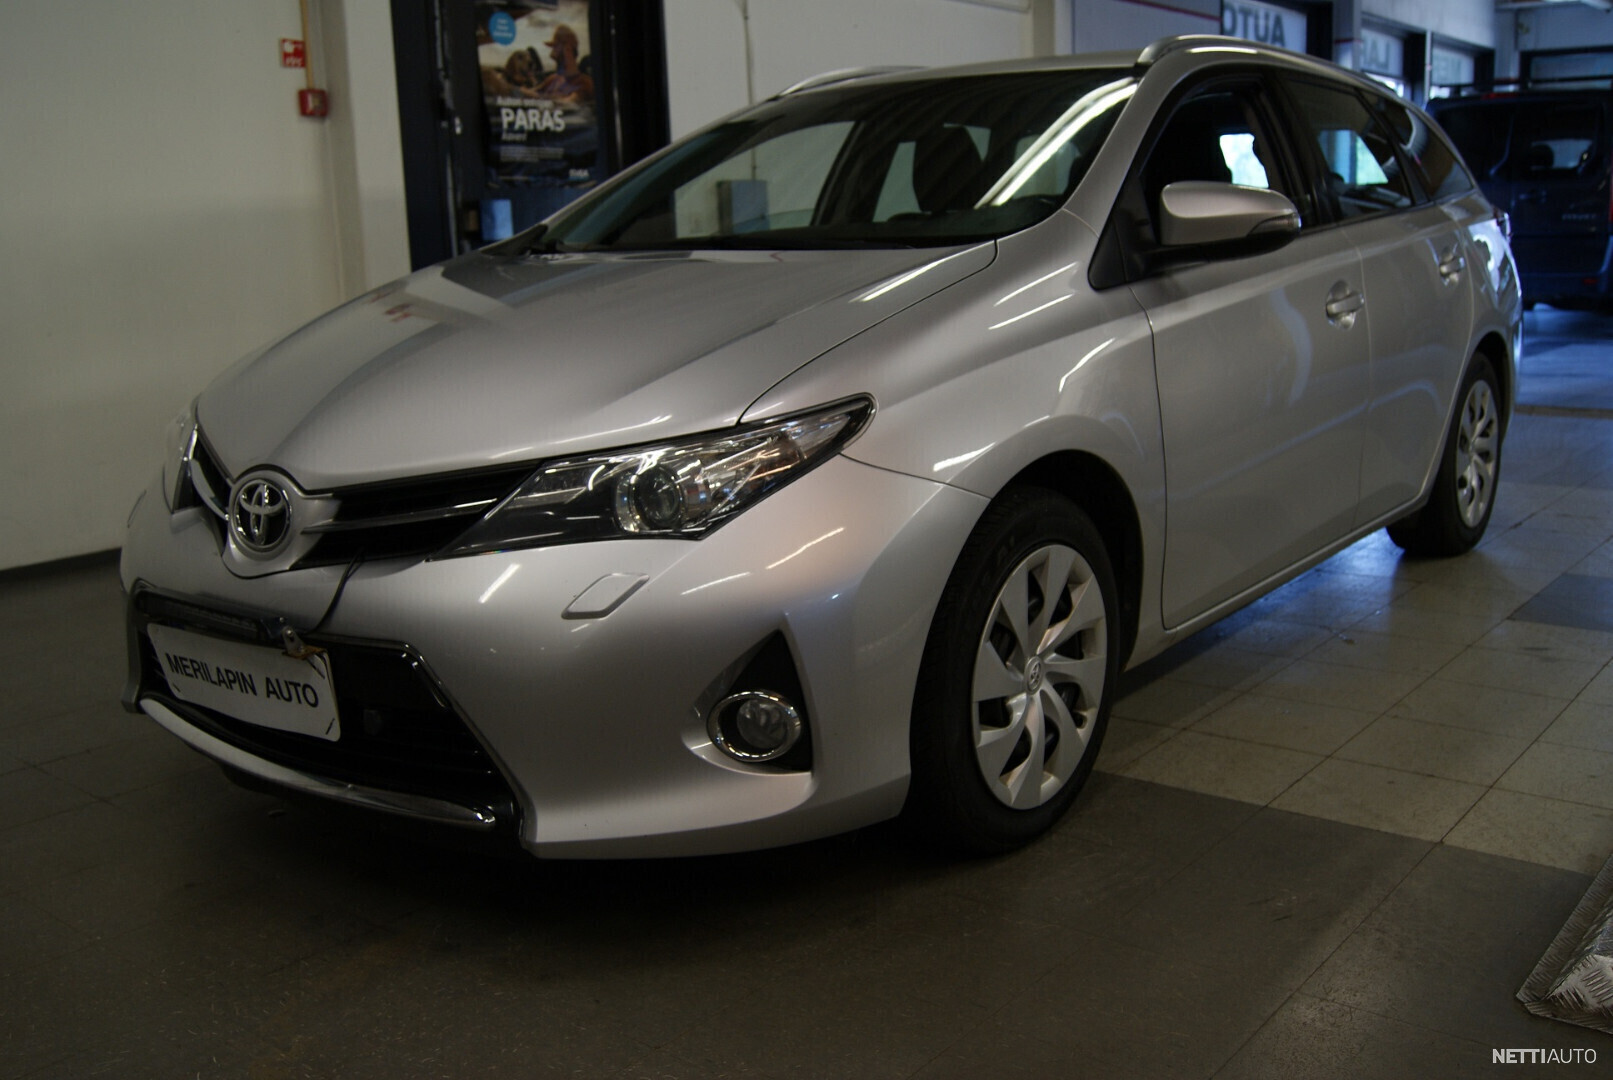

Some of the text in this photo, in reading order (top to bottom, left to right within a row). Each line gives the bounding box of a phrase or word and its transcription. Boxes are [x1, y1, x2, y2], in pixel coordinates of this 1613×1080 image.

[500, 107, 566, 133] PARAS
[165, 653, 319, 708] MERILAPIN AUTO
